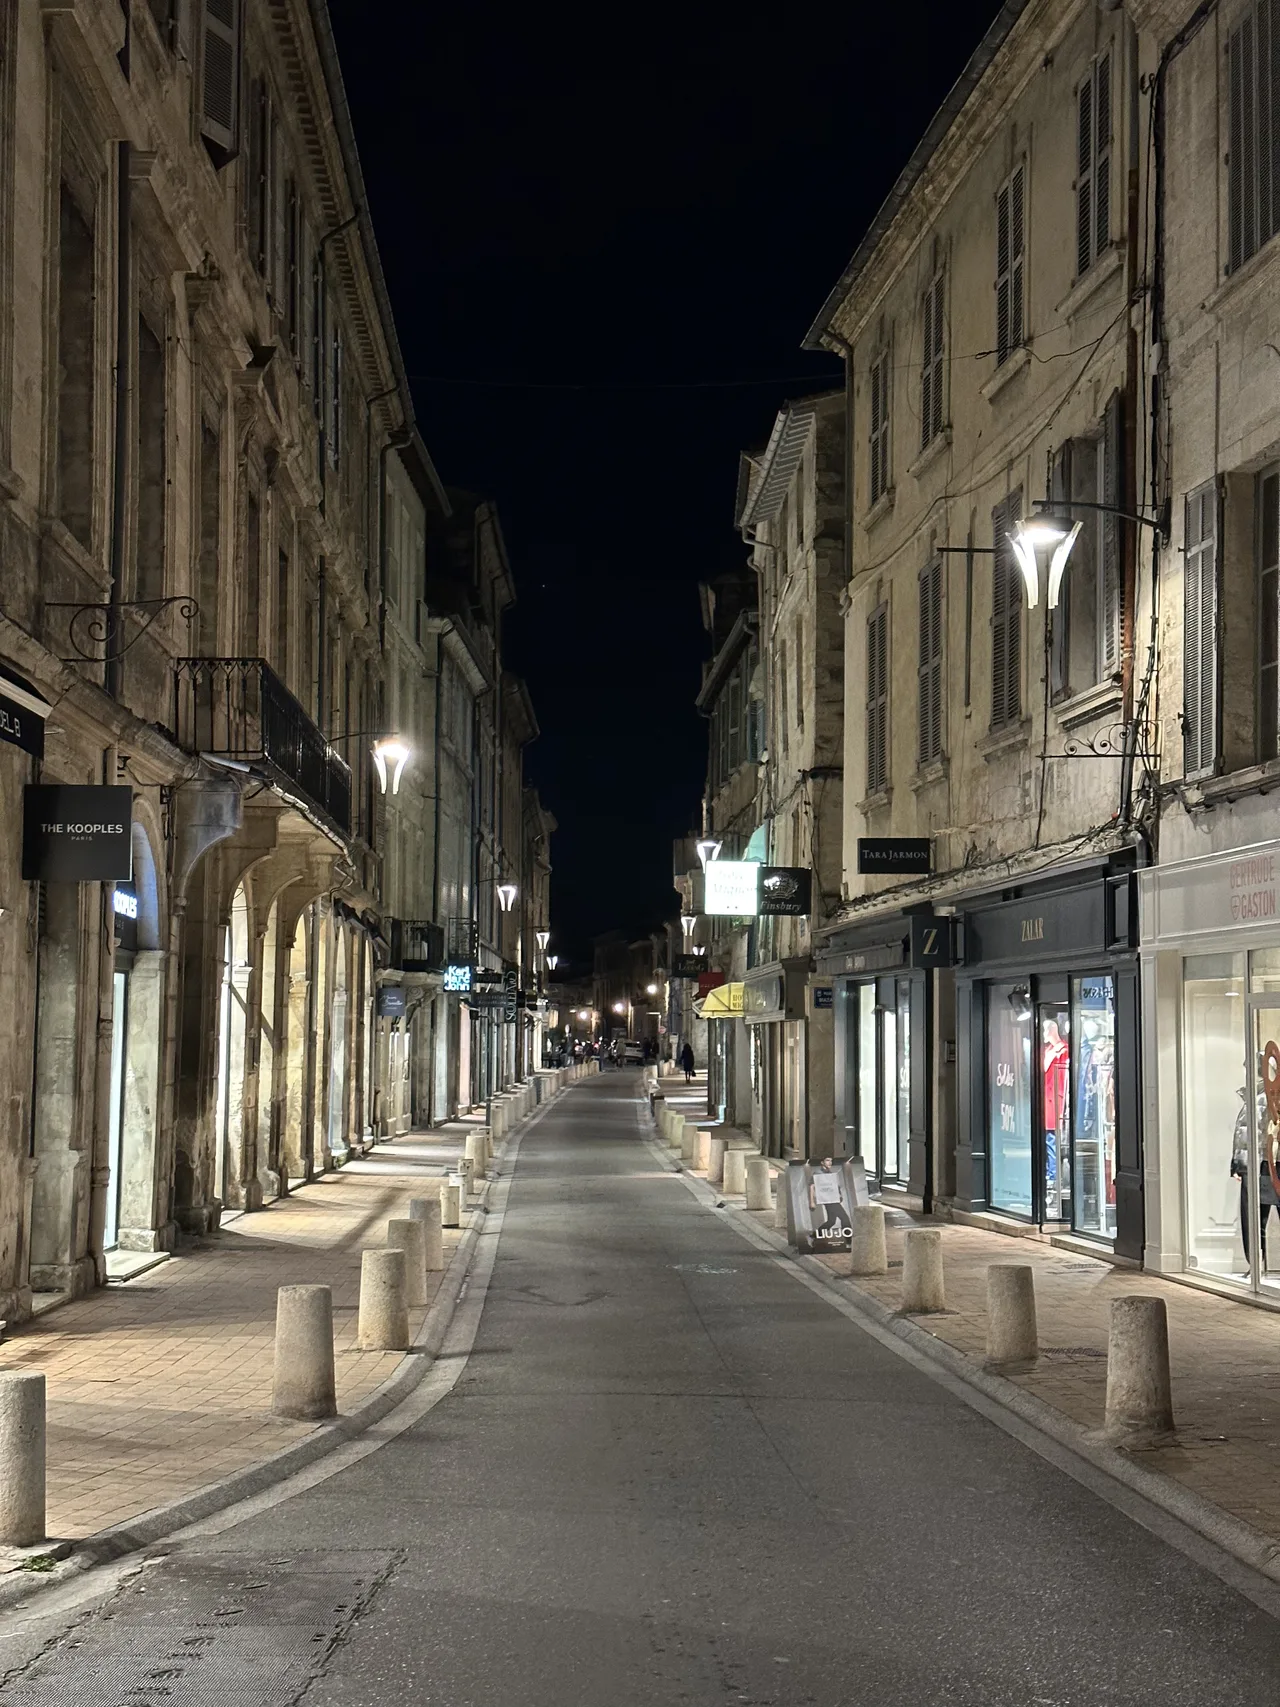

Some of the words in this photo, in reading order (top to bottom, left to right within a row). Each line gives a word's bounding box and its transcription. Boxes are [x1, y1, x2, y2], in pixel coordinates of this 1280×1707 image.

[41, 823, 64, 833] THE
[66, 823, 124, 834] KOOPLES
[862, 849, 887, 859] TARA
[888, 849, 928, 860] JARMON
[1230, 856, 1275, 889] GERTRUDE
[760, 901, 801, 912] Finsbury
[1241, 888, 1276, 919] GASTON
[1021, 917, 1044, 941] ZALAR
[922, 928, 939, 955] Z
[444, 981, 470, 991] John
